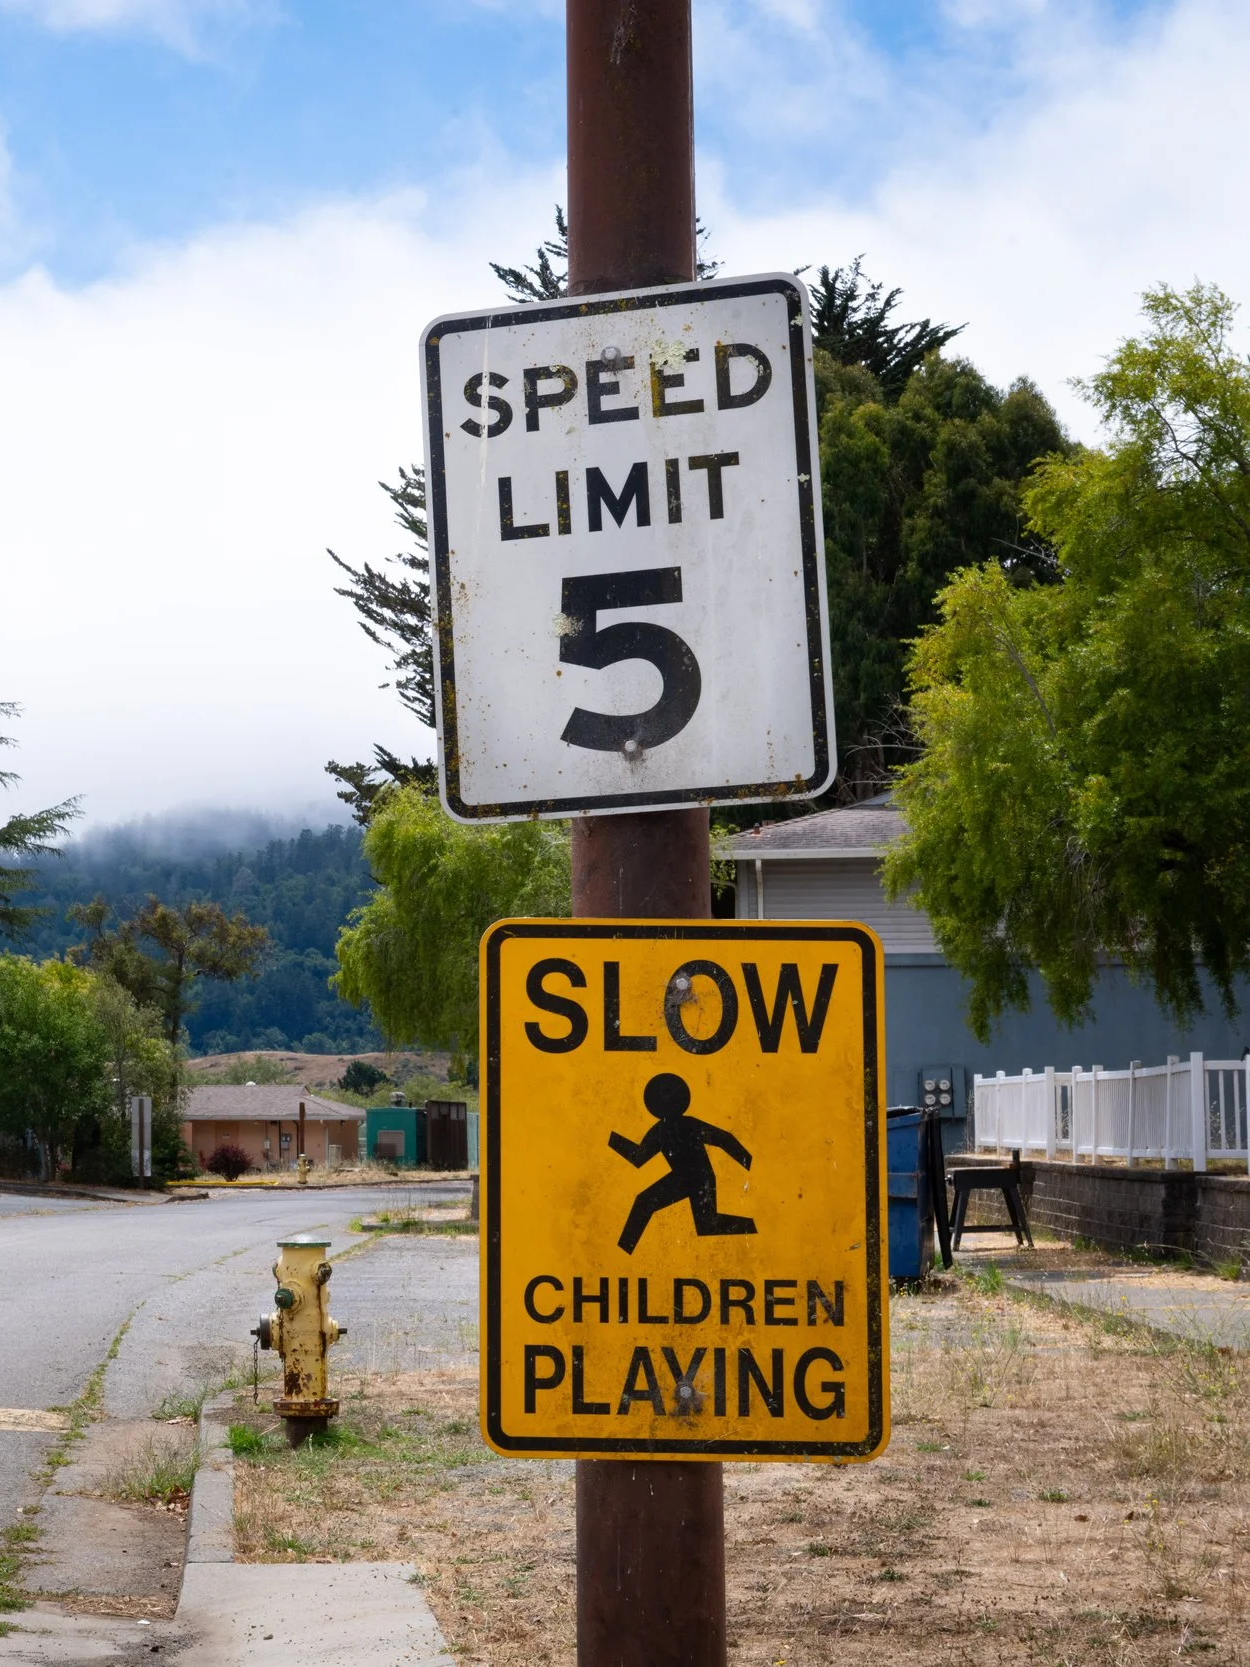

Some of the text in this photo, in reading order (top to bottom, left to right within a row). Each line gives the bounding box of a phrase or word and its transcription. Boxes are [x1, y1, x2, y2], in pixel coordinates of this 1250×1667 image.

[460, 343, 773, 438] SPEED
[498, 452, 740, 541] LIMIT
[559, 566, 702, 753] 5
[524, 957, 840, 1056] SLOW
[523, 1274, 849, 1327] CHILDREN
[523, 1344, 846, 1421] PLAYING
